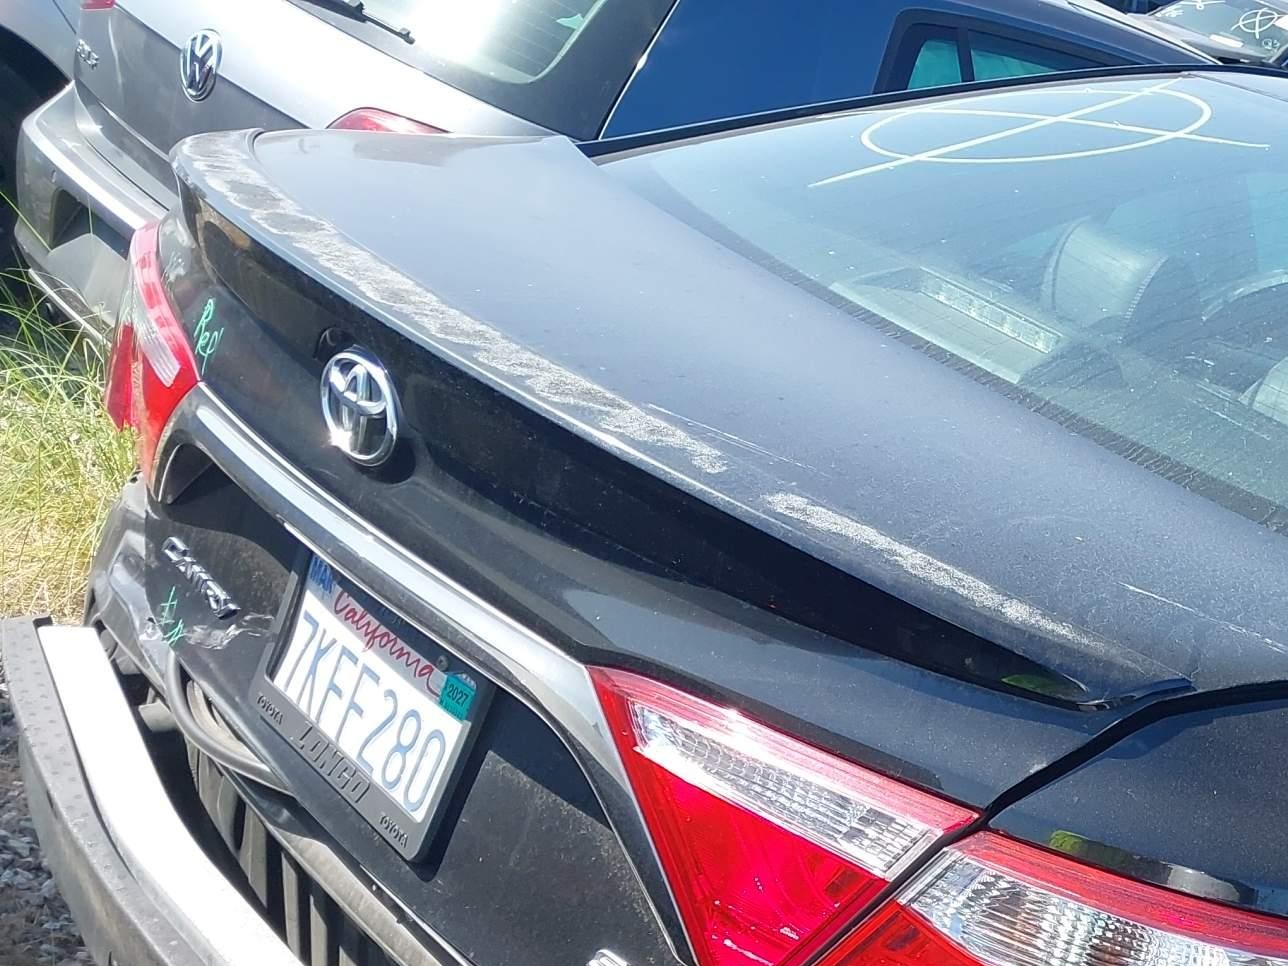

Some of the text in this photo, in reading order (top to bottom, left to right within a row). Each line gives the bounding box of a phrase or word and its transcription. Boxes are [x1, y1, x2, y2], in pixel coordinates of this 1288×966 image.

[162, 536, 241, 620] CAMRY
[334, 590, 440, 698] California
[256, 692, 284, 726] TOYOTA
[284, 610, 446, 812] 7KFF280
[446, 683, 469, 707] 2027
[298, 720, 371, 804] LONGO
[378, 812, 409, 849] TOYOTA
